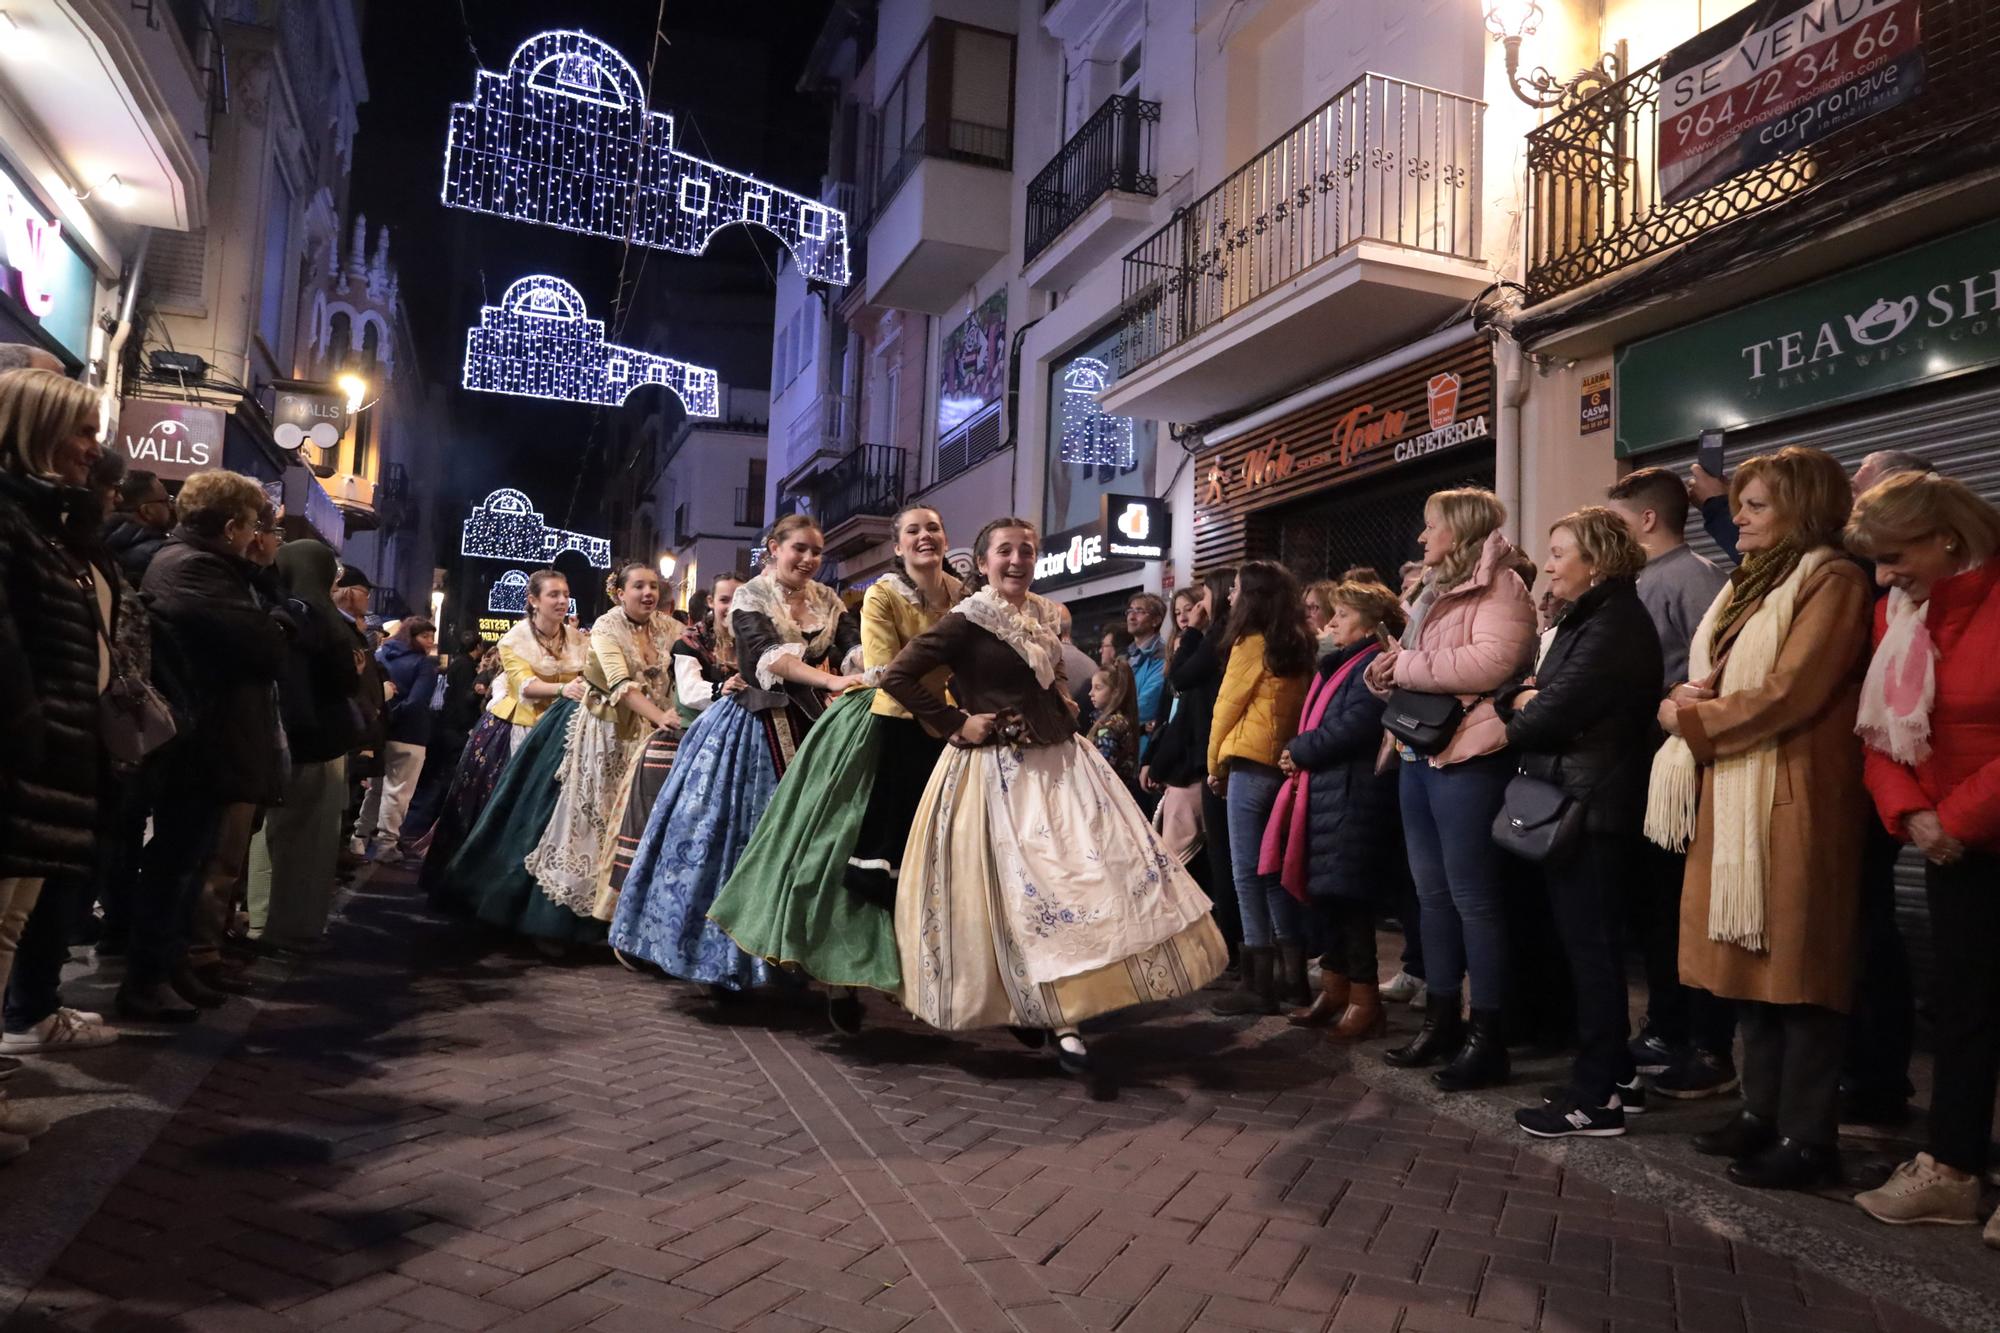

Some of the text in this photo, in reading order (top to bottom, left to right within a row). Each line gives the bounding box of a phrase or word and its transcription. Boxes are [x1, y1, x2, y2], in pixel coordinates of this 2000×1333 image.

[1674, 59, 1722, 107] SE
[1676, 11, 1899, 146] 964 72 34 66
[1684, 54, 1888, 157] www.caspronaveinmobiliaria.com
[1759, 64, 1898, 144] caspronave
[1742, 322, 1845, 380] TEA
[1855, 337, 1926, 368] WEST
[1582, 370, 1610, 386] ALARMA
[295, 404, 340, 419] VALLS
[1582, 403, 1609, 419] CASVA
[126, 435, 210, 465] VALLS
[1242, 438, 1295, 489] Wok
[1332, 404, 1409, 467] Town
[1394, 415, 1488, 463] CAFETERIA
[1033, 551, 1068, 580] octor
